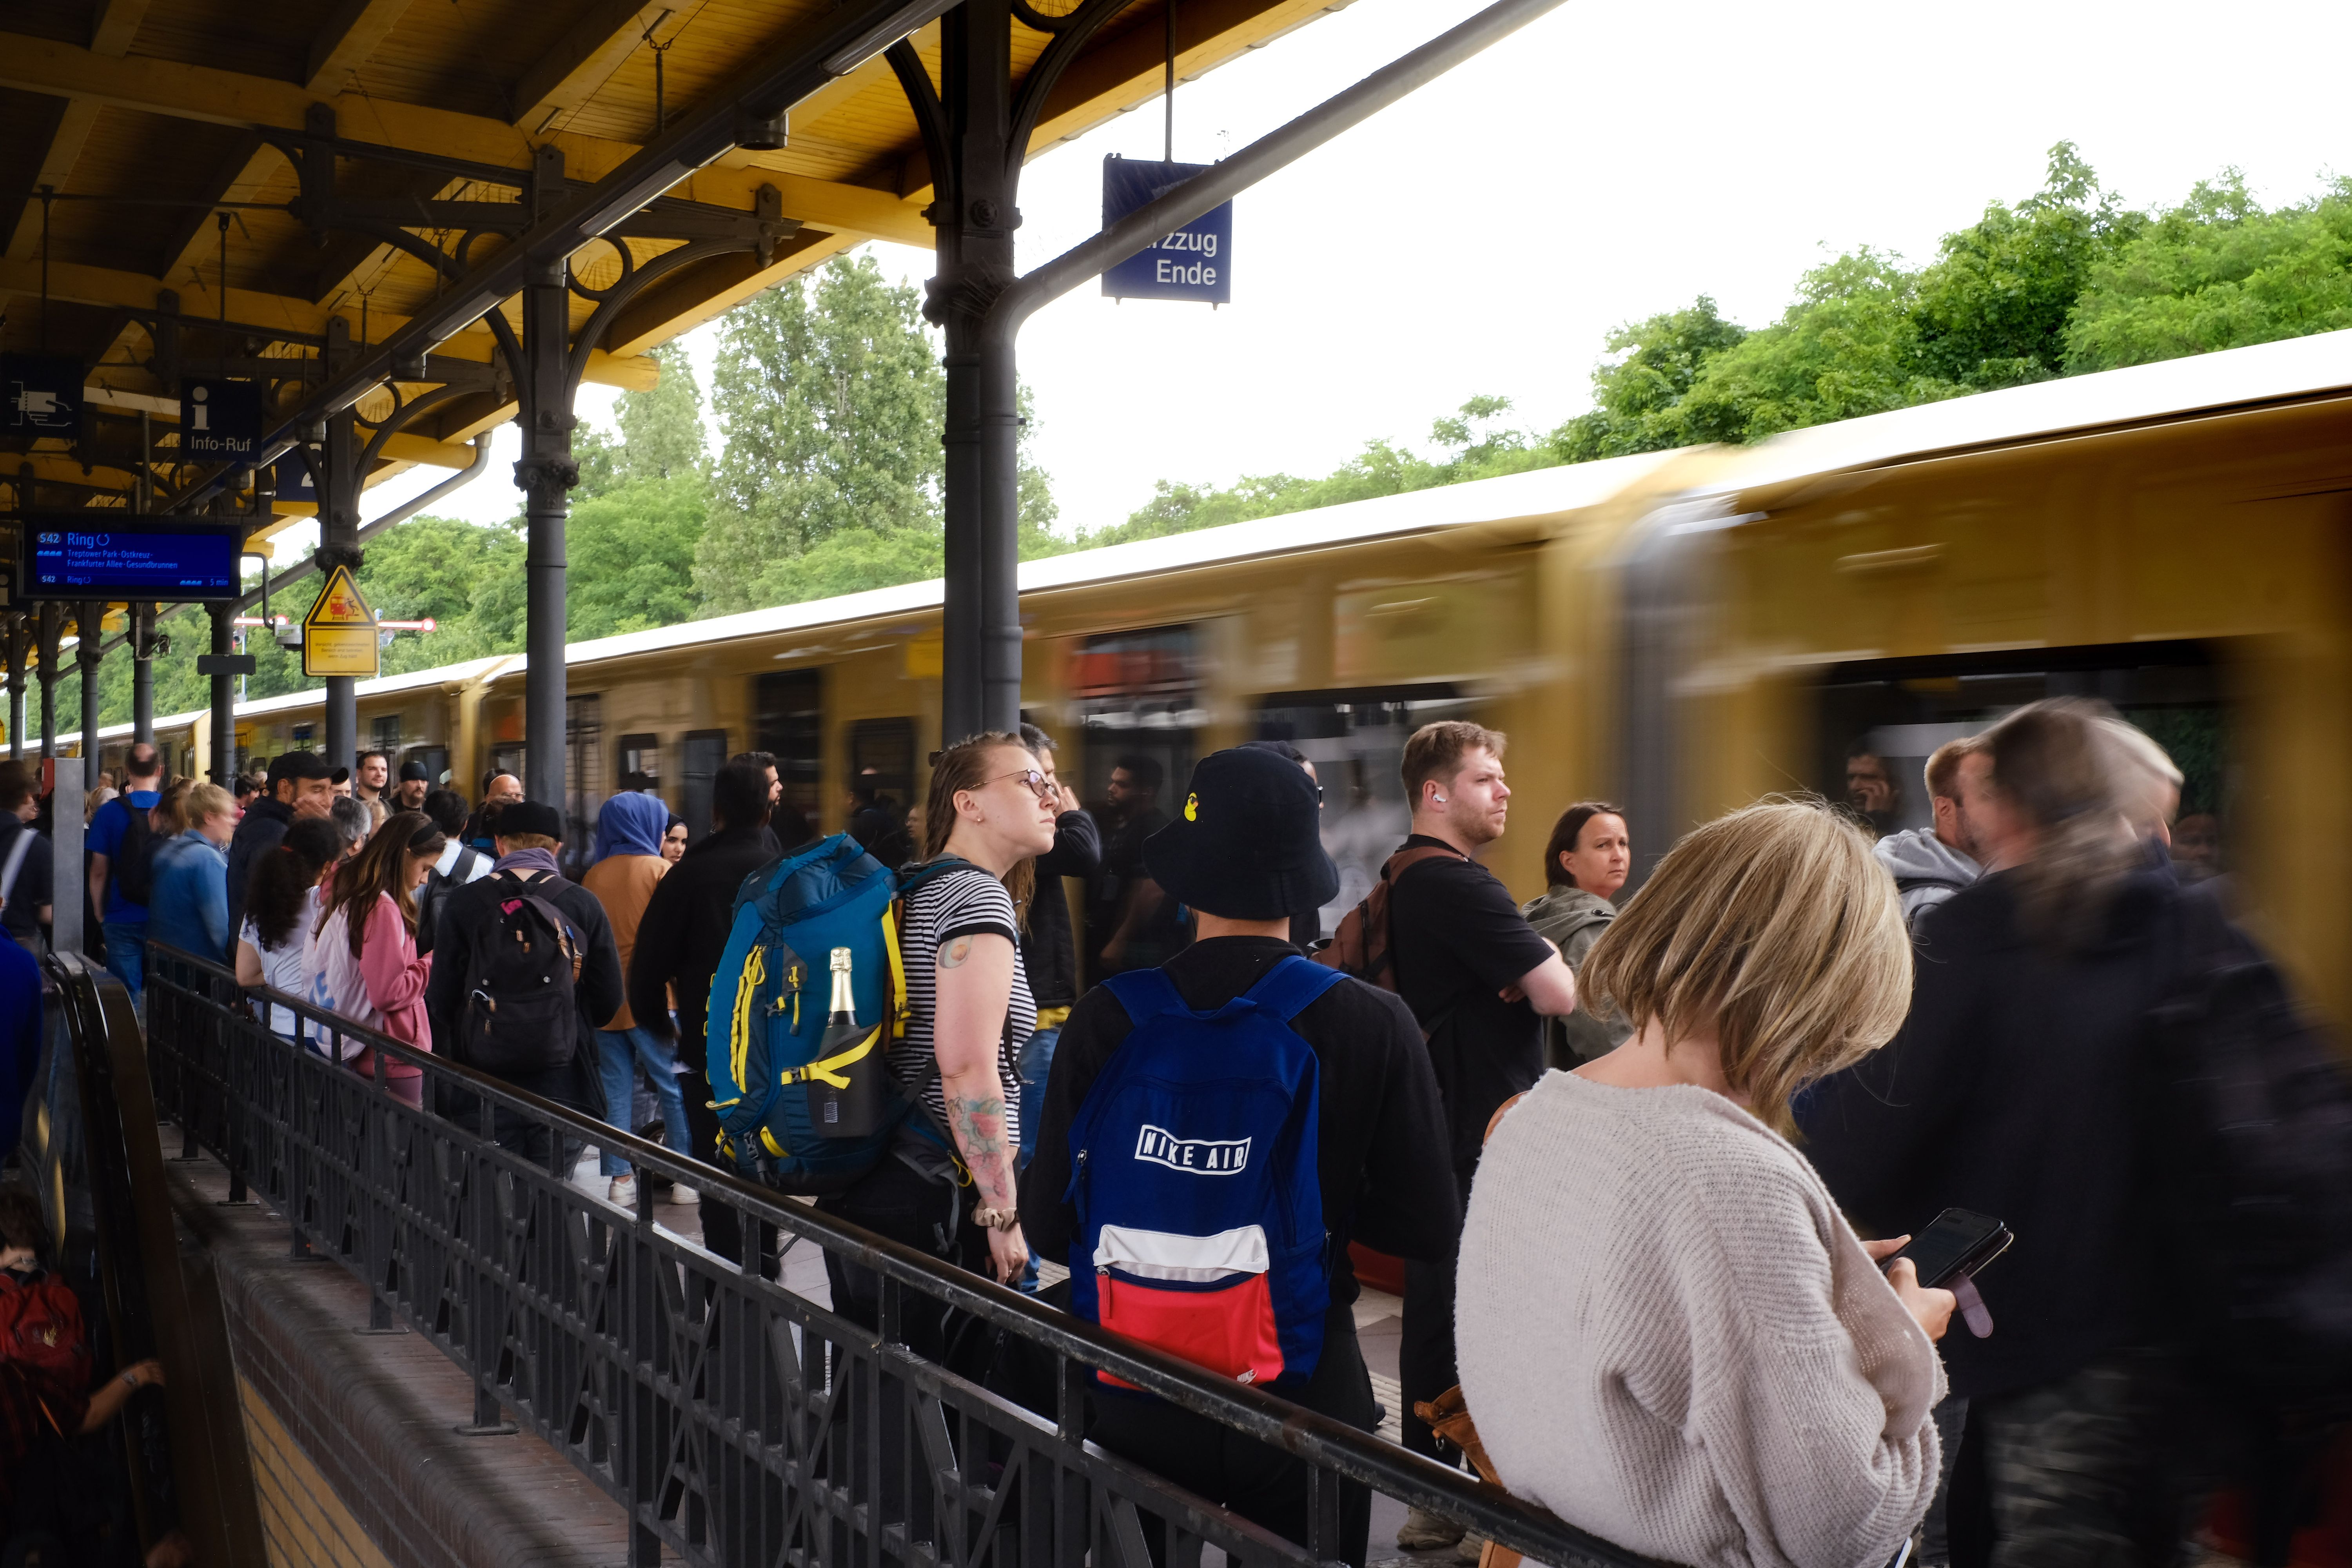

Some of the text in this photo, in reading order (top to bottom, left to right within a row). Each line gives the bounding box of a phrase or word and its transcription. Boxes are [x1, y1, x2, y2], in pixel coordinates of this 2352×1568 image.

[1147, 232, 1217, 258] zzug
[1157, 259, 1216, 285] Ende
[191, 436, 251, 452] Info-Ruf
[40, 532, 94, 549] S42 Ring
[67, 549, 101, 559] Treptower
[67, 559, 105, 568] Frankfurter
[42, 575, 56, 583] S42
[67, 575, 82, 585] Ring
[1143, 1131, 1245, 1169] NIKE AIR
